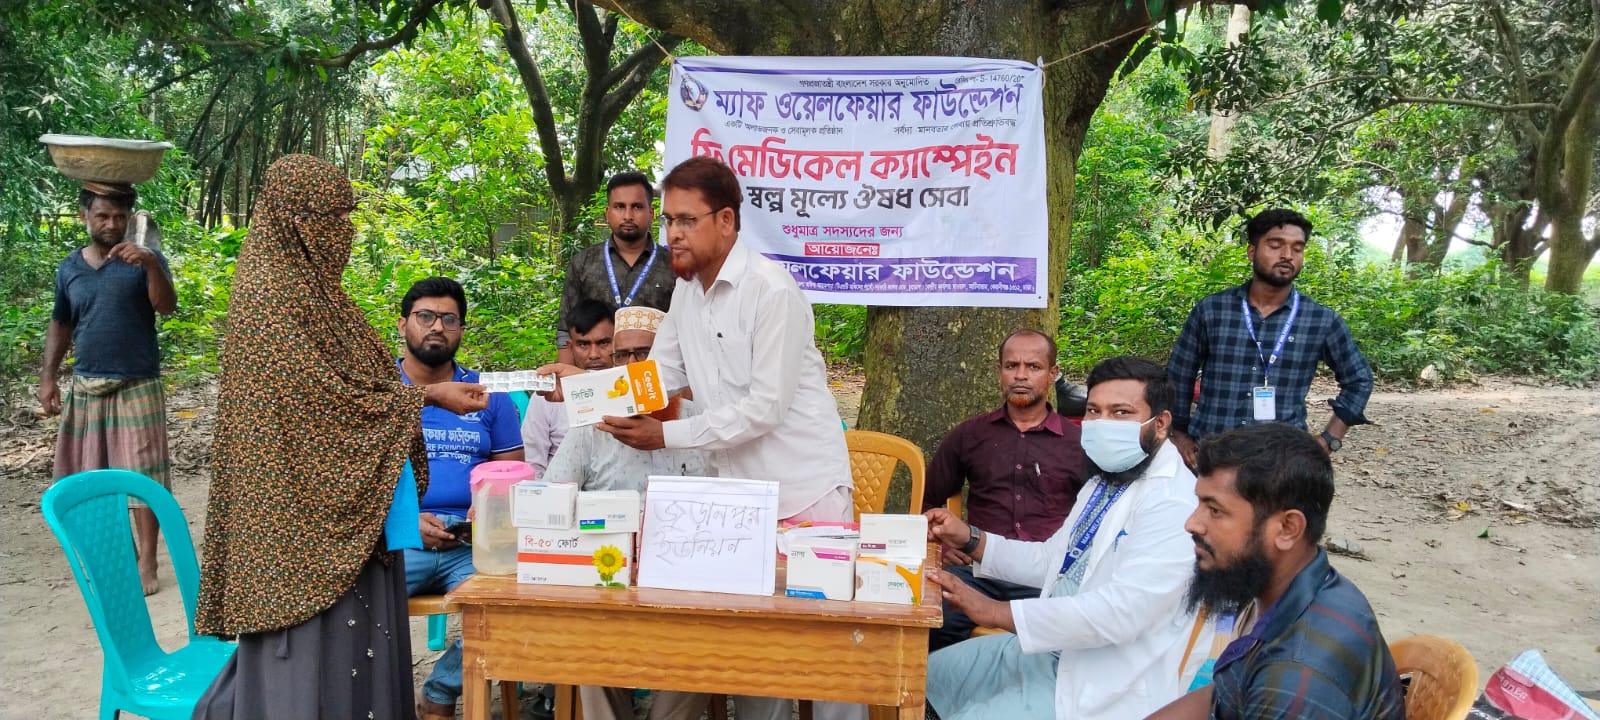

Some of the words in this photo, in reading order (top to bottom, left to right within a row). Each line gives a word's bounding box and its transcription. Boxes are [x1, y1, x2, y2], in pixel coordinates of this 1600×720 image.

[836, 79, 867, 88] বাংলাদেশ
[869, 79, 892, 87] সরকার
[894, 76, 930, 88] অনুমোদিত
[713, 88, 768, 121] ম্যাফ
[775, 89, 904, 122] ওয়েলফেয়ার
[910, 79, 1024, 121] ফাউন্ডেশন
[725, 119, 743, 128] একটি
[893, 124, 913, 135] সর্বদা
[728, 136, 865, 182] মেডিকেল
[870, 133, 1020, 180] ক্যাম্পেইন
[746, 186, 786, 213] স্বল্প
[789, 187, 848, 218] মূল্যে
[853, 183, 914, 210] ঔষধ
[919, 185, 972, 209] সেবা
[781, 224, 819, 239] শুধুমাত্র
[822, 226, 875, 238] সদস্যদের
[879, 226, 905, 239] জন্য
[889, 257, 1018, 282] ফাউন্ডেশন
[643, 370, 658, 401] Ceevit
[570, 388, 595, 401] সিভিট
[437, 443, 480, 453] FOUNDATION
[556, 536, 580, 549] ফোর্ট
[654, 530, 753, 566] ইউনিয়ন
